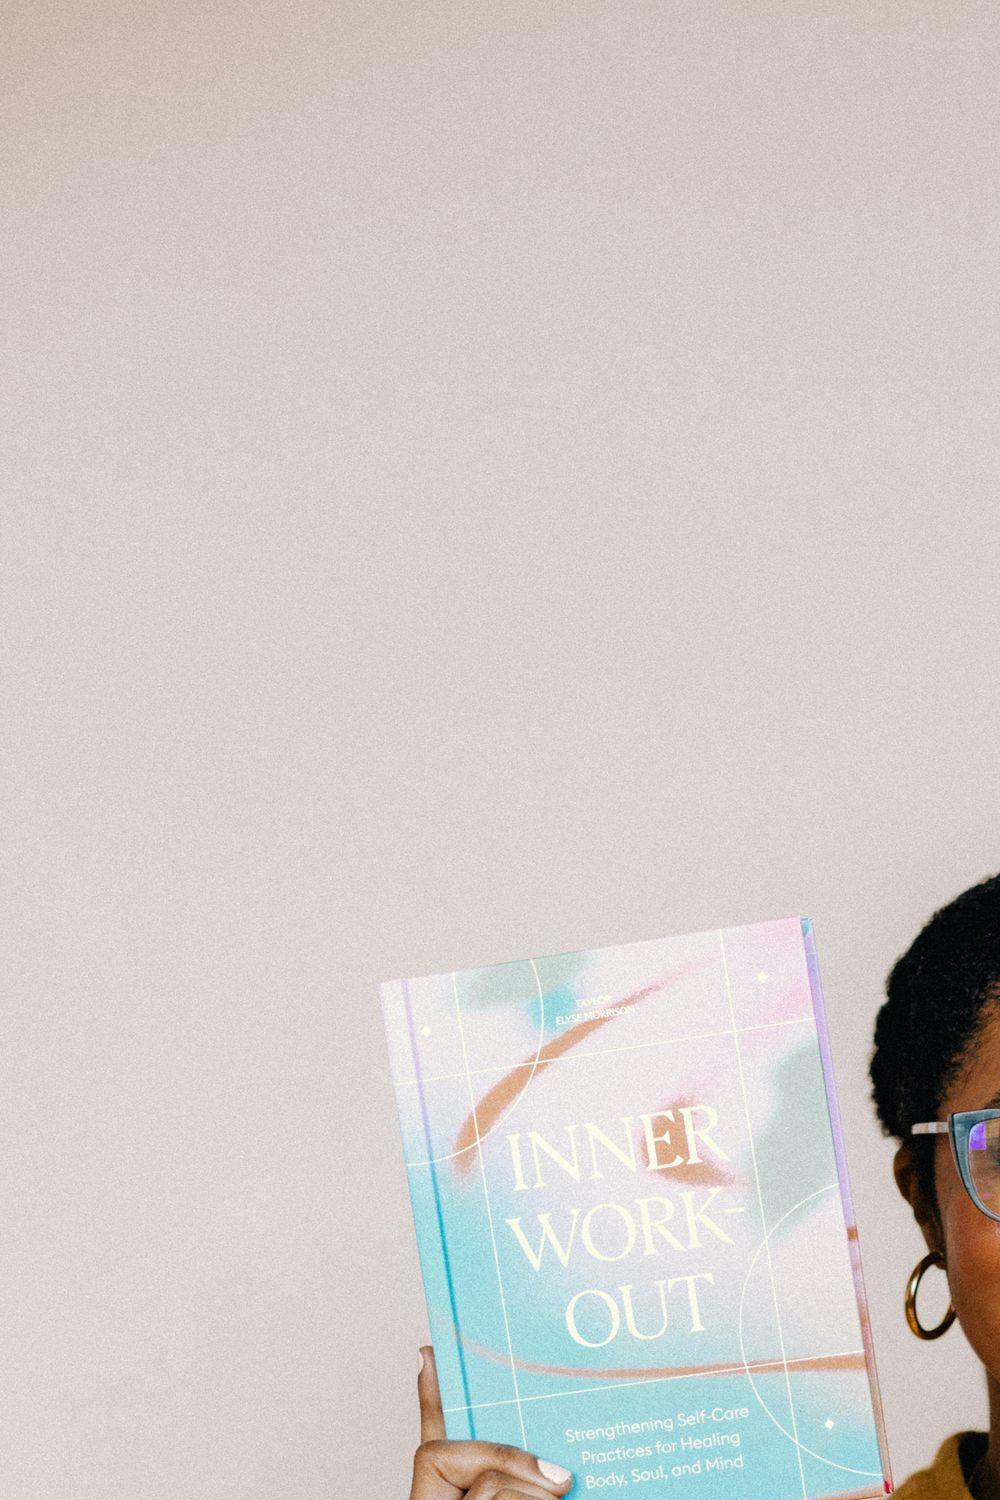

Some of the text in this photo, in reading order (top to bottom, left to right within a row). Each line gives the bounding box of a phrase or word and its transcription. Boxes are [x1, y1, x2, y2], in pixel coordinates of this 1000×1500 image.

[555, 1004, 636, 1025] ELYSE MORRISON
[506, 1104, 730, 1191] INNER
[505, 1186, 745, 1272] WORK-
[565, 1272, 716, 1348] OUT
[565, 1407, 750, 1441] Strengthening Self-Care
[581, 1432, 741, 1465] Practices for Healing
[585, 1453, 745, 1489] Body, Soul, and Mind
